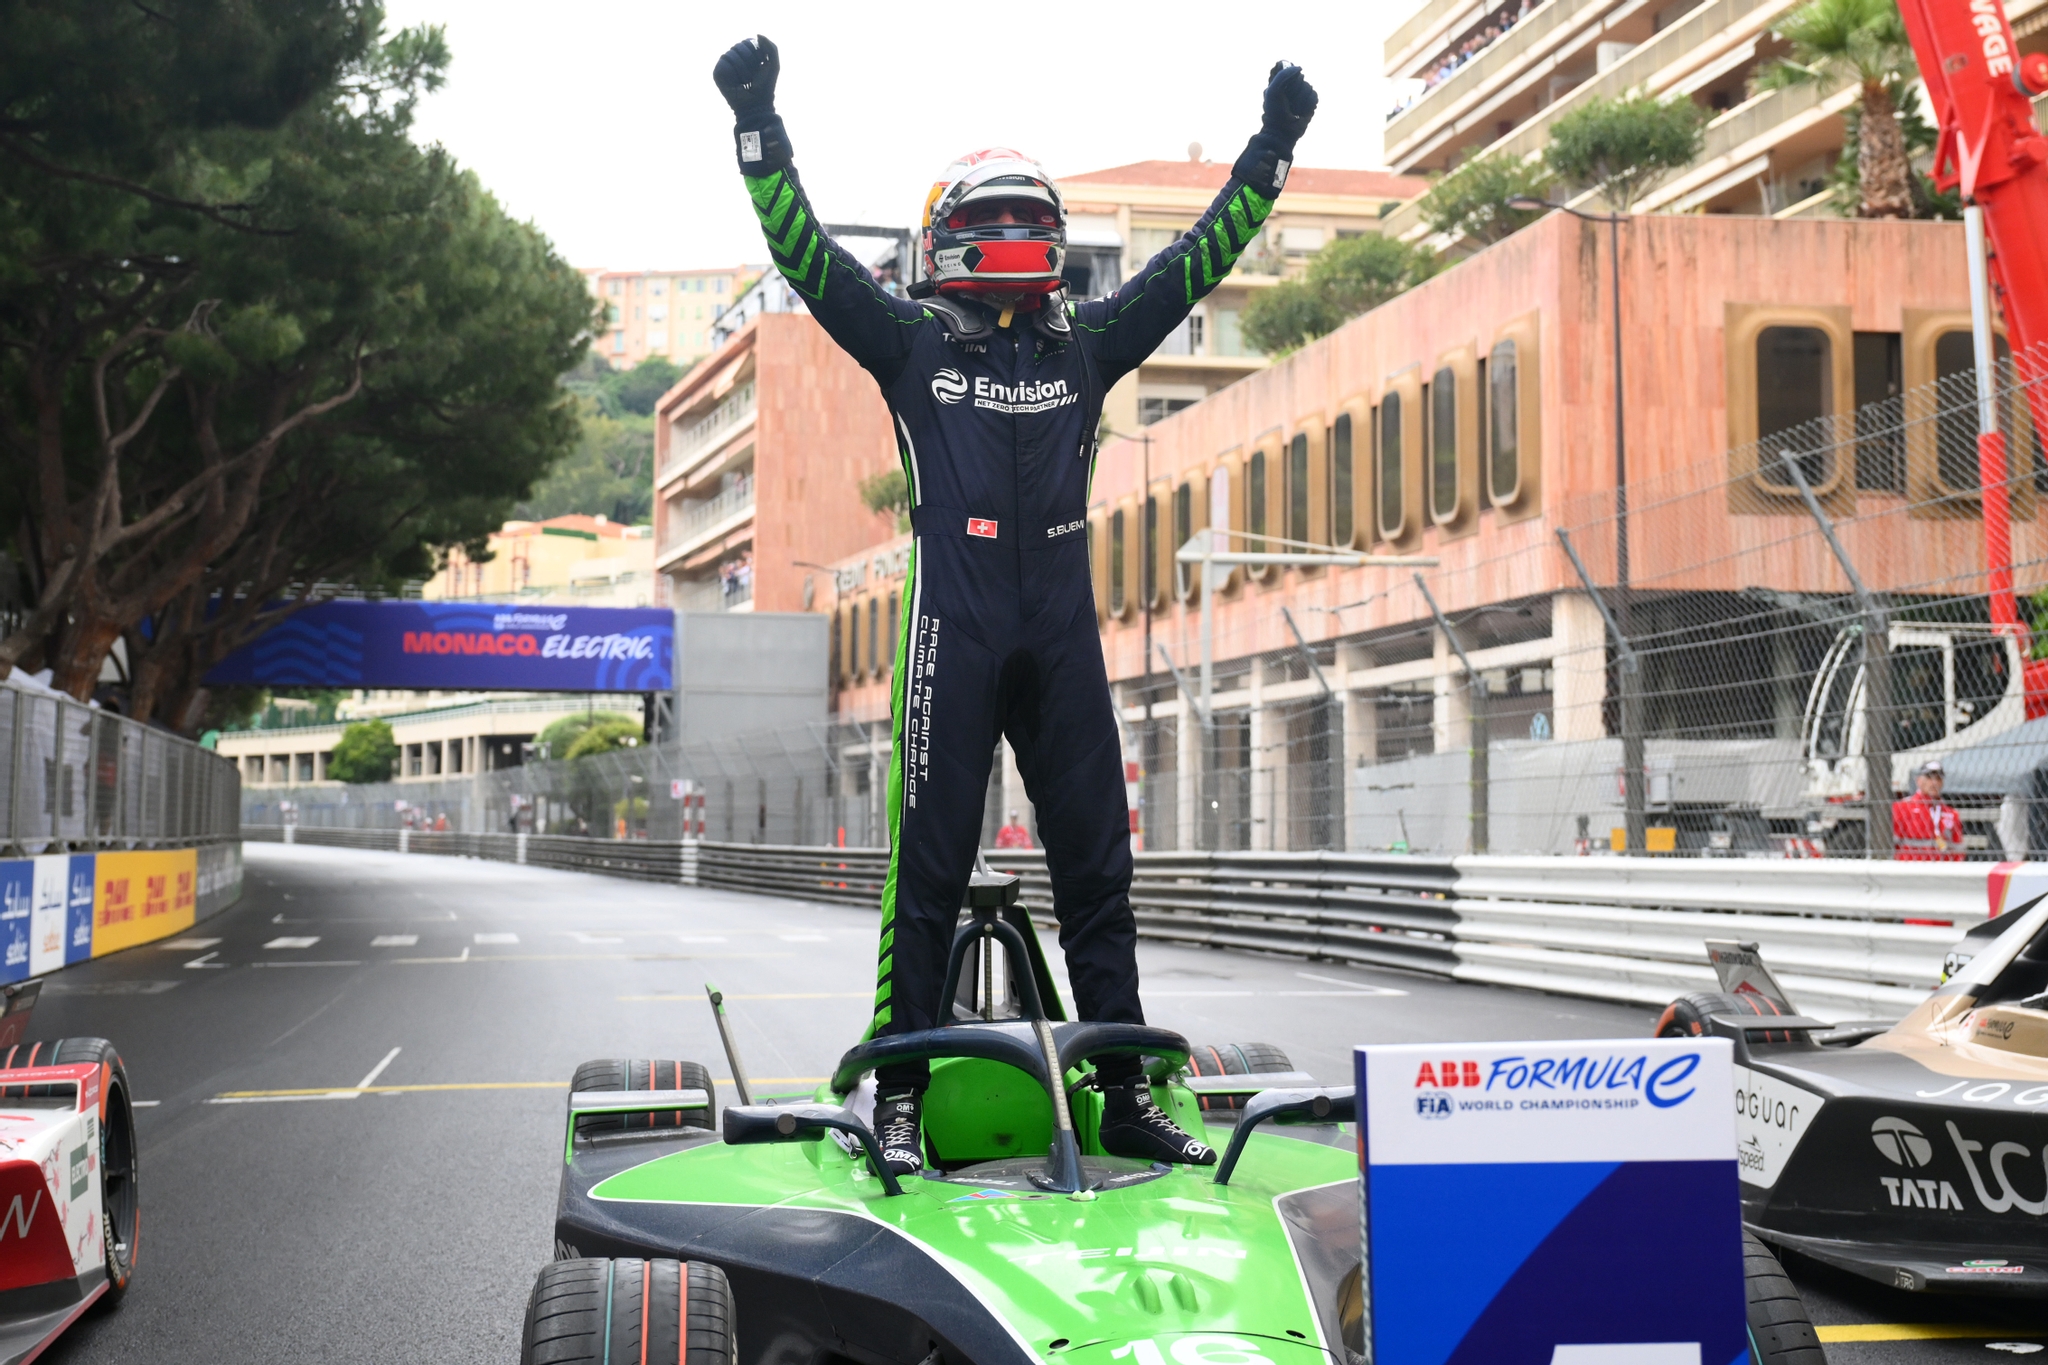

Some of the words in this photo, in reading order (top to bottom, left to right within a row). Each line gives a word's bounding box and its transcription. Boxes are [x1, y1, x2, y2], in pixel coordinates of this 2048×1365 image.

[975, 377, 1068, 403] Envision
[992, 402, 1010, 411] ZERO
[1030, 402, 1056, 412] PARTNER
[403, 631, 541, 656] MONACO.
[541, 633, 654, 661] ELECTRIC.
[912, 615, 928, 709] CLIMATE
[925, 618, 940, 677] RACE
[919, 686, 932, 781] AGAINST
[909, 718, 919, 809] CHANGE
[1415, 1061, 1481, 1088] ABB
[1486, 1056, 1647, 1091] FORMULA
[1459, 1099, 1514, 1111] WORLD
[1520, 1098, 1640, 1110] CHAMPIONSHIP
[884, 1149, 921, 1167] OMP
[1945, 1120, 2048, 1216] tc
[1880, 1177, 1964, 1211] TATA
